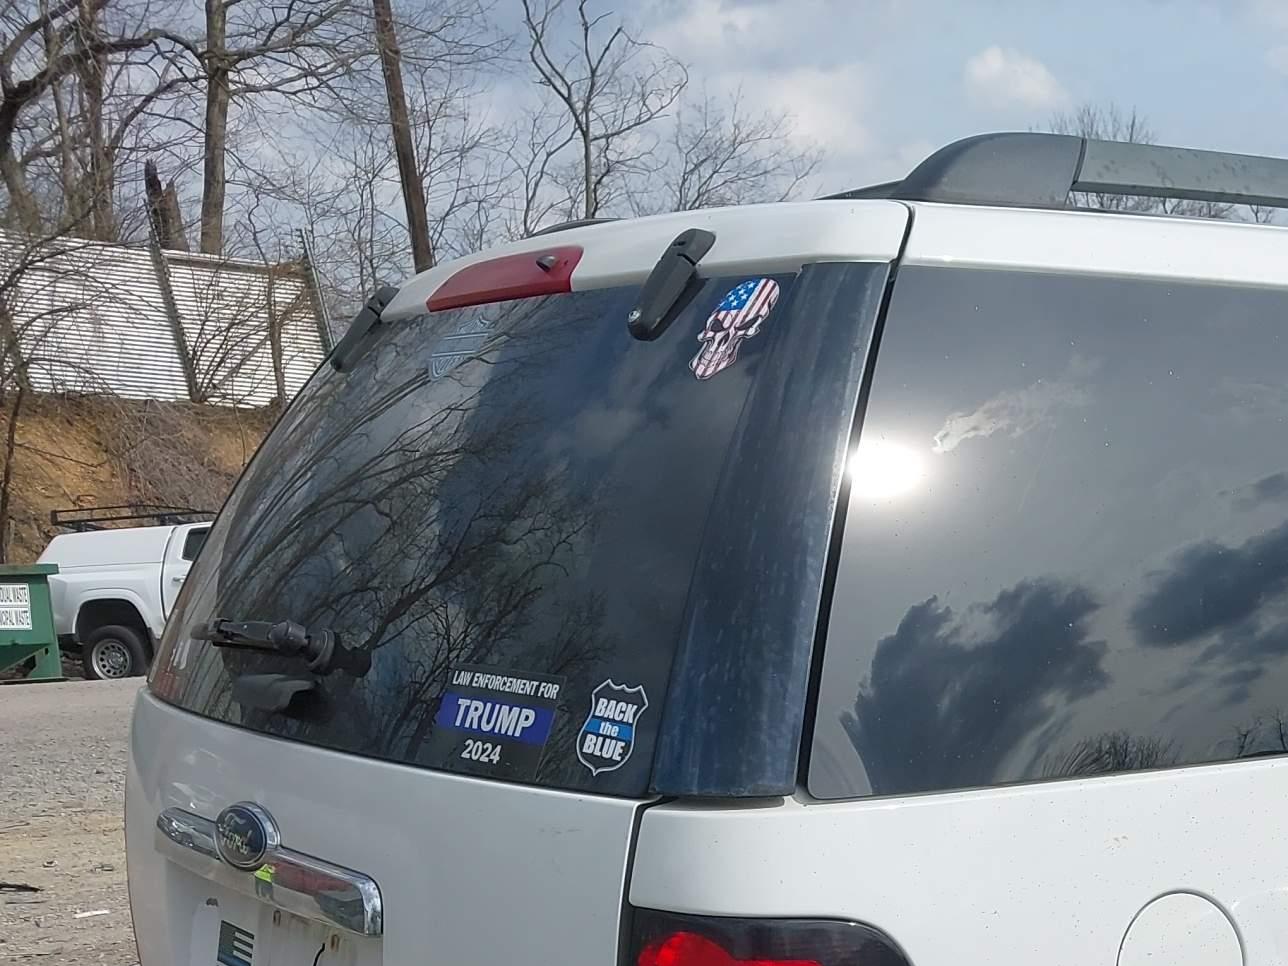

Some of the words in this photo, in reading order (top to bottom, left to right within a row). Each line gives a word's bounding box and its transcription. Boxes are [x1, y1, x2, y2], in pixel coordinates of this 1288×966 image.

[452, 670, 470, 687] LAW
[472, 673, 539, 696] ENFORCEMENT
[540, 683, 560, 700] FOR
[454, 698, 536, 737] TRUMP
[594, 697, 638, 724] BACK
[599, 720, 620, 737] the
[461, 739, 502, 765] 2024
[582, 733, 626, 762] BLUE
